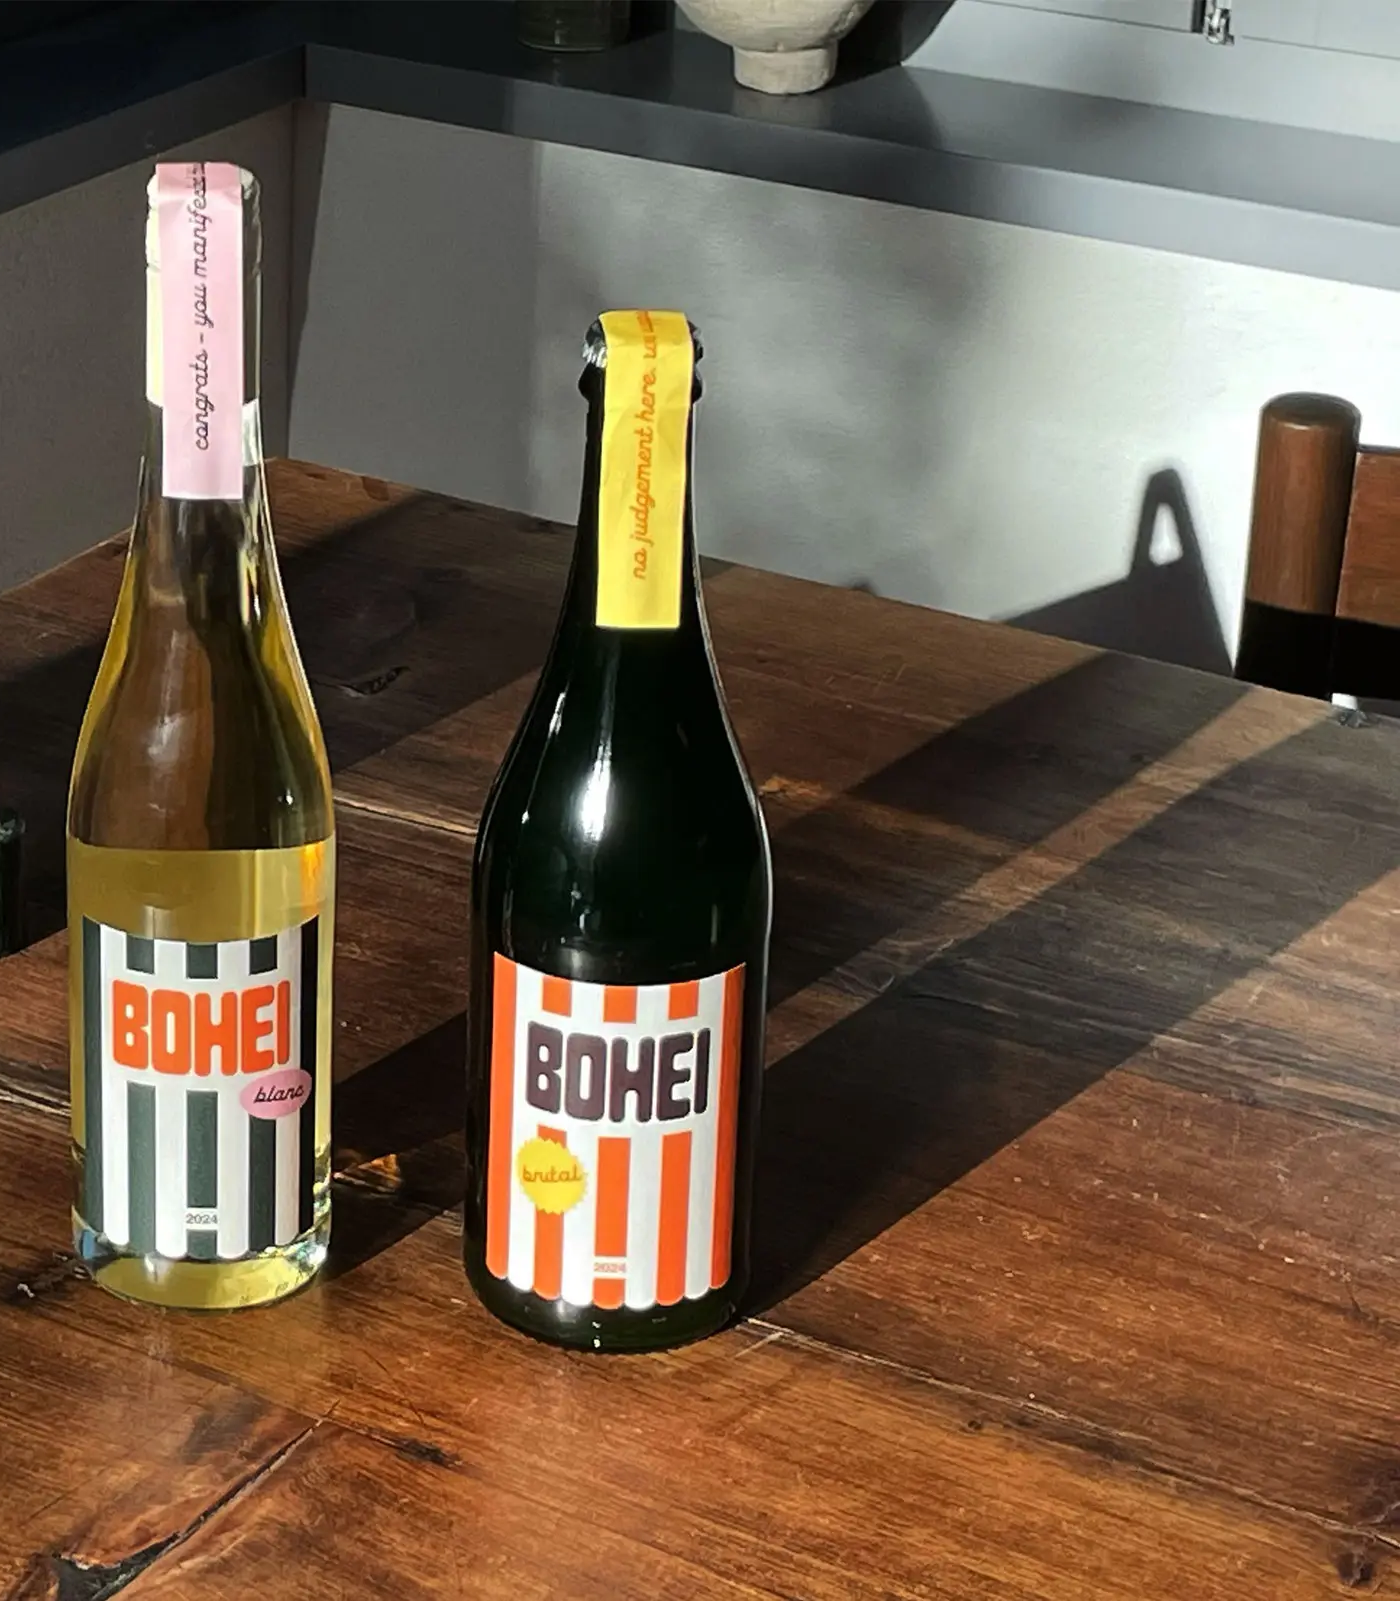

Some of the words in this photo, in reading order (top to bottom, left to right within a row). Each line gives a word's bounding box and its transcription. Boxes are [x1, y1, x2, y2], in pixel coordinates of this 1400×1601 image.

[194, 284, 215, 329] you
[188, 350, 215, 451] congrats
[629, 427, 656, 547] judgement
[633, 548, 648, 580] no
[112, 979, 291, 1077] BOHEI
[253, 1084, 305, 1104] blanc
[525, 1020, 711, 1123] BOHEI
[522, 1164, 583, 1183] brutal
[185, 1213, 218, 1225] 2024
